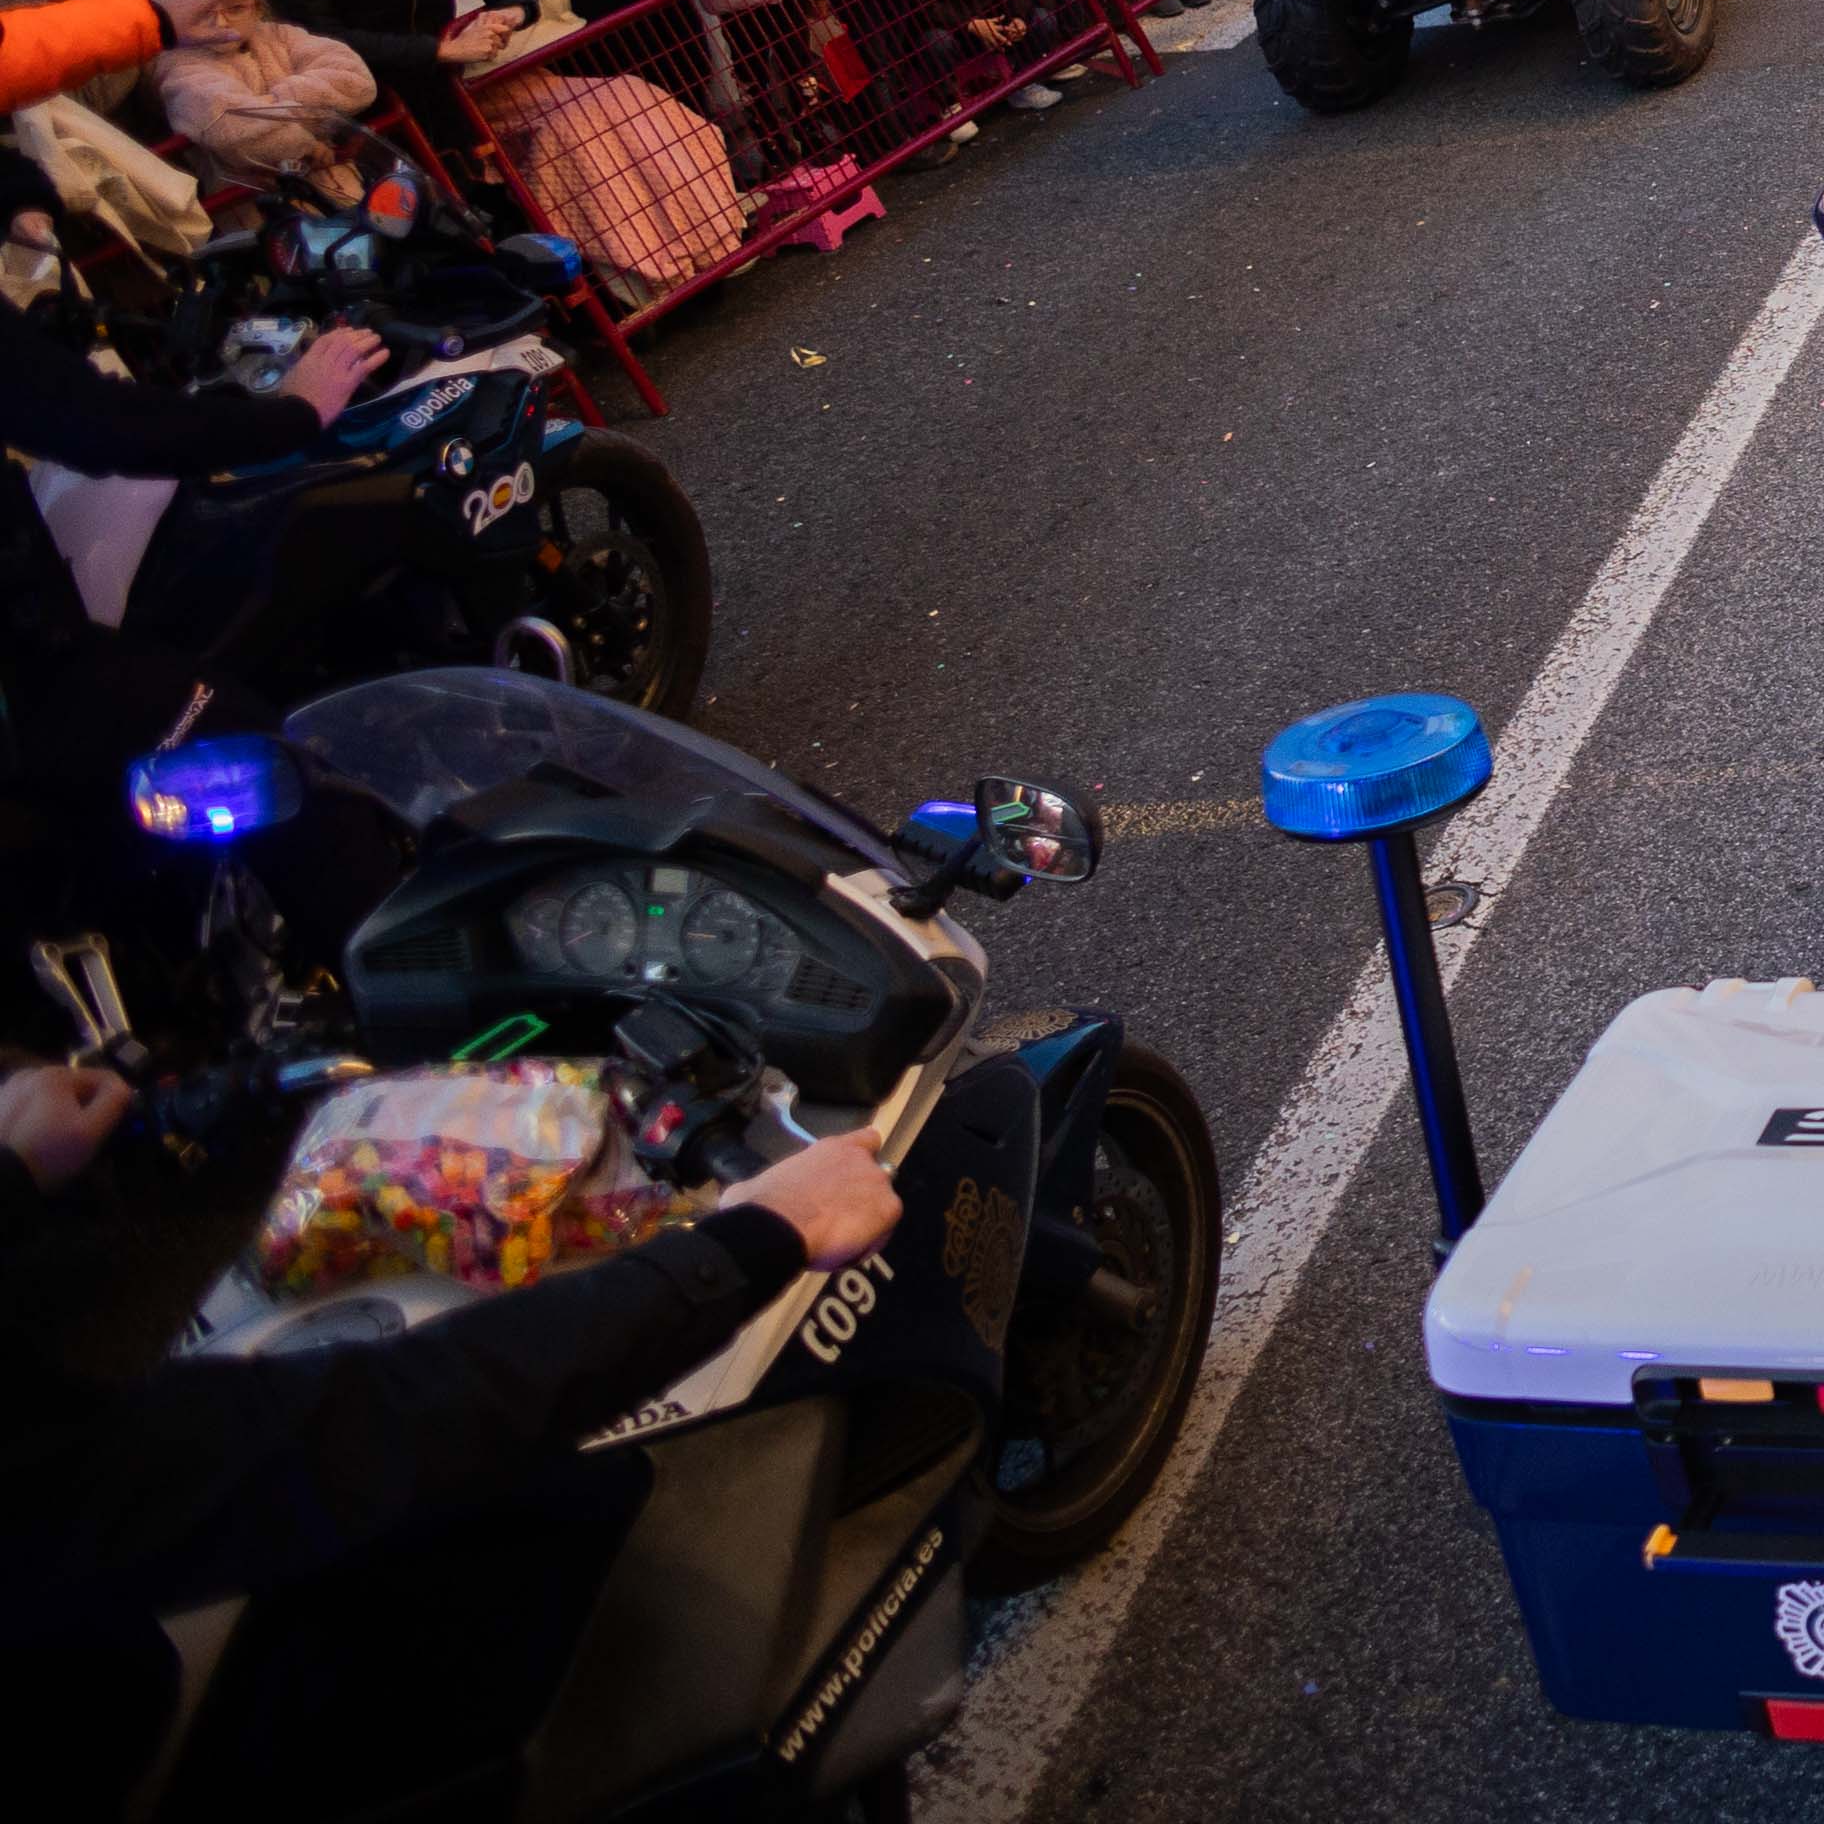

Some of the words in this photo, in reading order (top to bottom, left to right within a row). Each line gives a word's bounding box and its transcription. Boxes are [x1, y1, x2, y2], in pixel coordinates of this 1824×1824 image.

[401, 377, 475, 430] @policia
[464, 462, 535, 536] 200
[778, 1528, 944, 1762] www.policia.es
